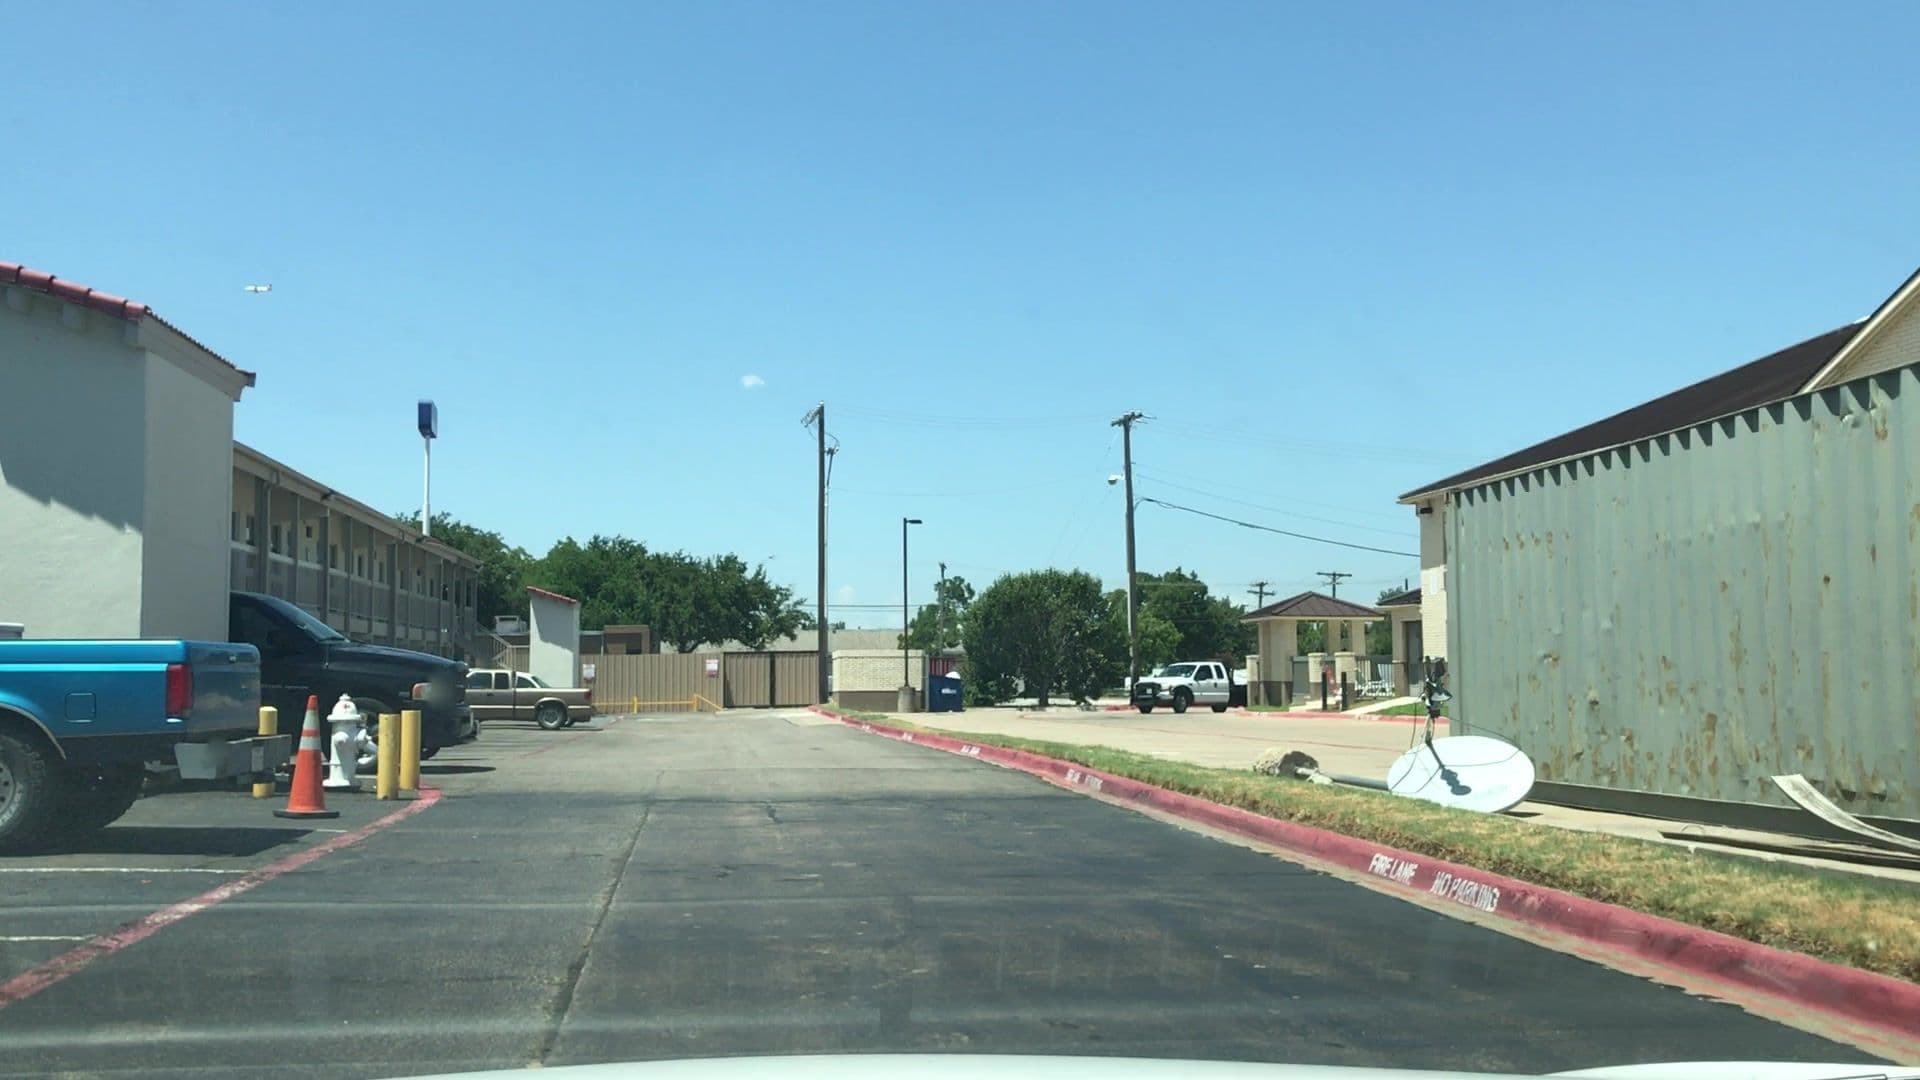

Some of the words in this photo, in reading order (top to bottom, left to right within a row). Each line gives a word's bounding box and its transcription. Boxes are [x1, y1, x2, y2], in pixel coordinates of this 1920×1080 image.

[1368, 853, 1393, 877] FIRE
[1389, 859, 1419, 886] LANE
[1430, 871, 1452, 896] NO
[1448, 878, 1500, 912] PARKING
